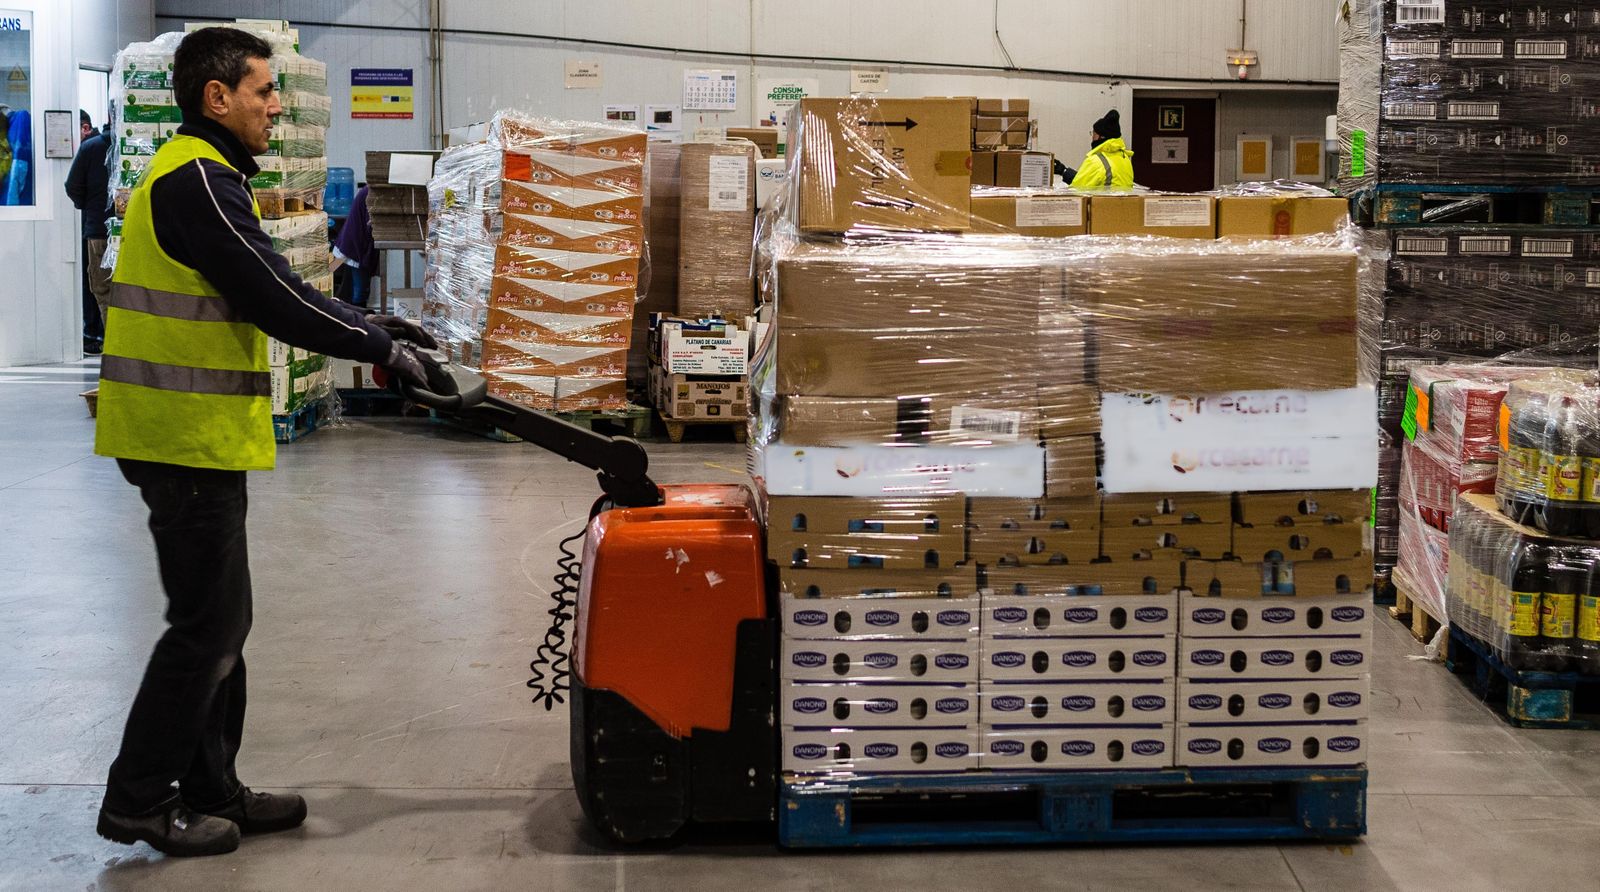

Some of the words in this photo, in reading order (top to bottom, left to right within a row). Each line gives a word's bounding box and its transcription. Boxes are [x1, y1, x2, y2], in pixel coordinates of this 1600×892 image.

[795, 613, 826, 621] DANONE
[867, 613, 897, 621] DANONE
[939, 613, 968, 621] DANONE
[995, 610, 1025, 618] DANONE
[1066, 611, 1096, 619] DANONE
[1136, 610, 1166, 618] DANONE
[1194, 611, 1224, 619] DANONE
[1264, 610, 1293, 618] DANONE
[1333, 609, 1362, 617] DANONE
[794, 655, 825, 663] DANONE
[866, 656, 896, 664] DANONE
[937, 656, 967, 664] DANONE
[994, 655, 1023, 663] DANONE
[1064, 654, 1094, 662] DANONE
[1135, 653, 1164, 661] DANONE
[1193, 653, 1223, 661] DANONE
[1263, 653, 1292, 661] DANONE
[1332, 653, 1361, 661] DANONE
[795, 700, 825, 708] DANONE
[866, 701, 896, 709] DANONE
[937, 701, 967, 709] DANONE
[993, 699, 1023, 707] DANONE
[1064, 698, 1093, 706] DANONE
[1134, 698, 1164, 706] DANONE
[1190, 697, 1220, 705] DANONE
[1260, 696, 1290, 704] DANONE
[1330, 695, 1359, 703] DANONE
[993, 743, 1023, 751] DANONE
[1063, 743, 1093, 751] DANONE
[1133, 743, 1163, 751] DANONE
[1190, 741, 1220, 749] DANONE
[1259, 740, 1289, 748] DANONE
[1329, 739, 1358, 747] DANONE
[795, 747, 825, 755] DANONE
[866, 746, 896, 754] DANONE
[937, 745, 967, 753] DANONE
